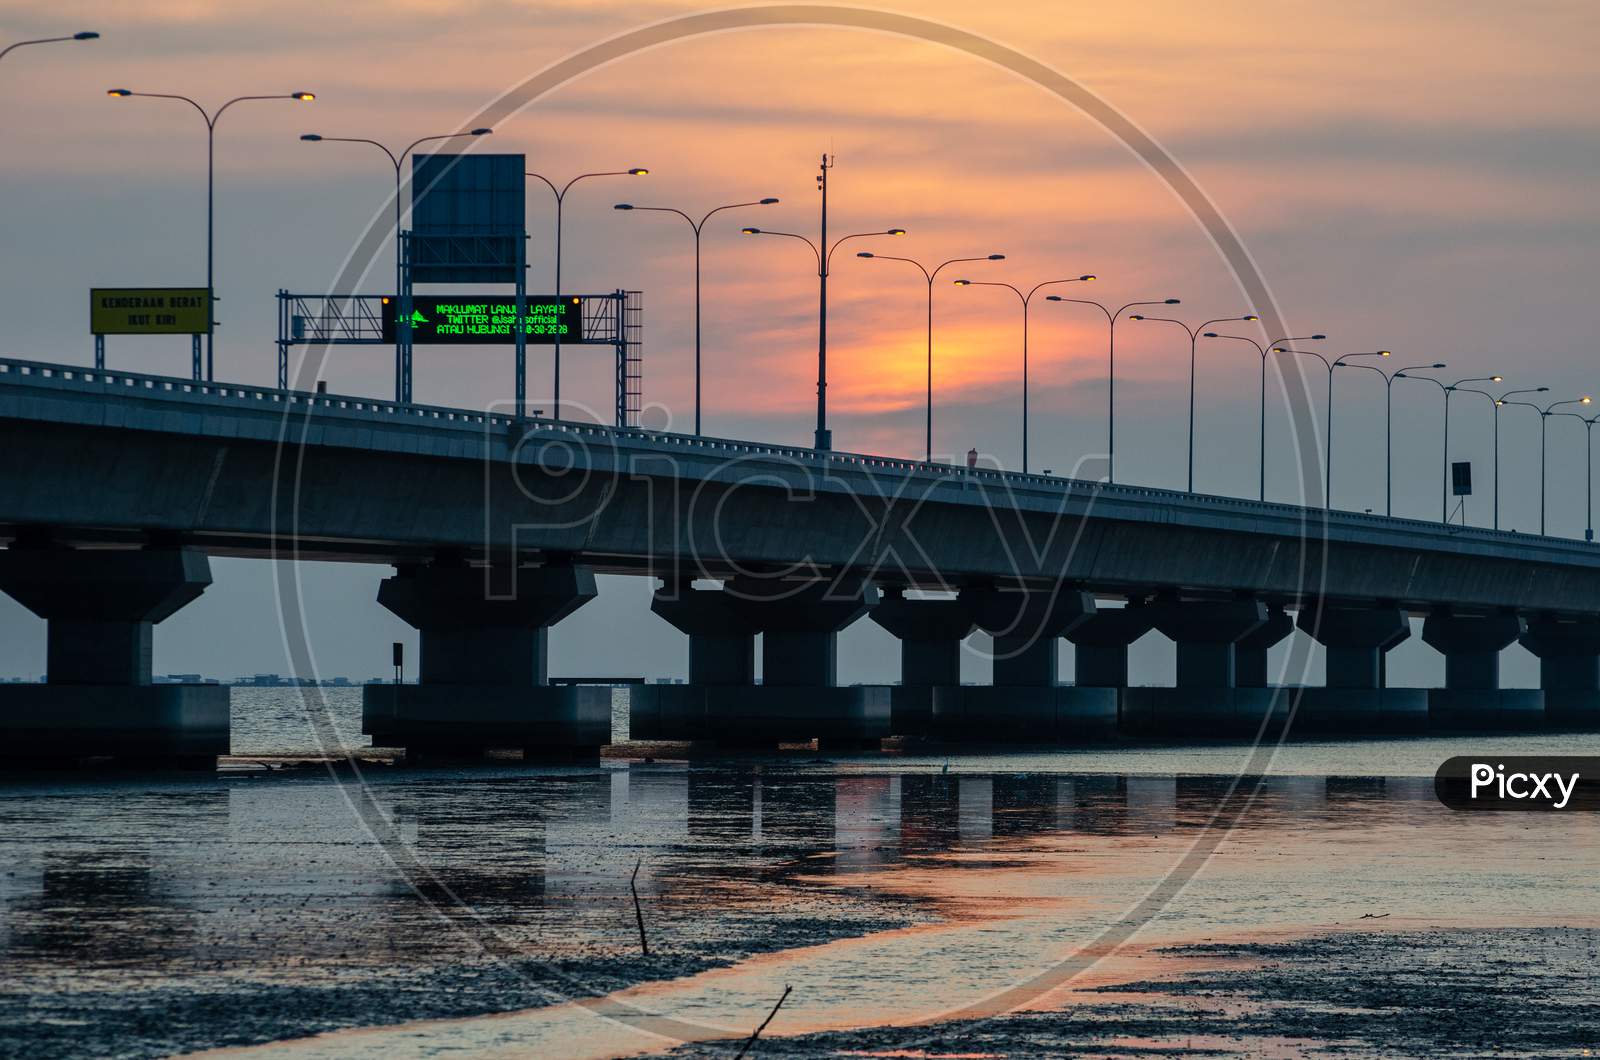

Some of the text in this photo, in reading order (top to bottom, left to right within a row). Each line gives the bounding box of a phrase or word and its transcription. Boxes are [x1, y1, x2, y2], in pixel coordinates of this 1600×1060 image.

[101, 296, 203, 308] KENDERAAN BERAT
[436, 304, 488, 314] MAKLUMAT
[128, 314, 176, 325] IKUT KIRI
[446, 314, 489, 324] TWITTER
[436, 324, 464, 334] ATAU
[466, 324, 510, 334] HUBUNGI
